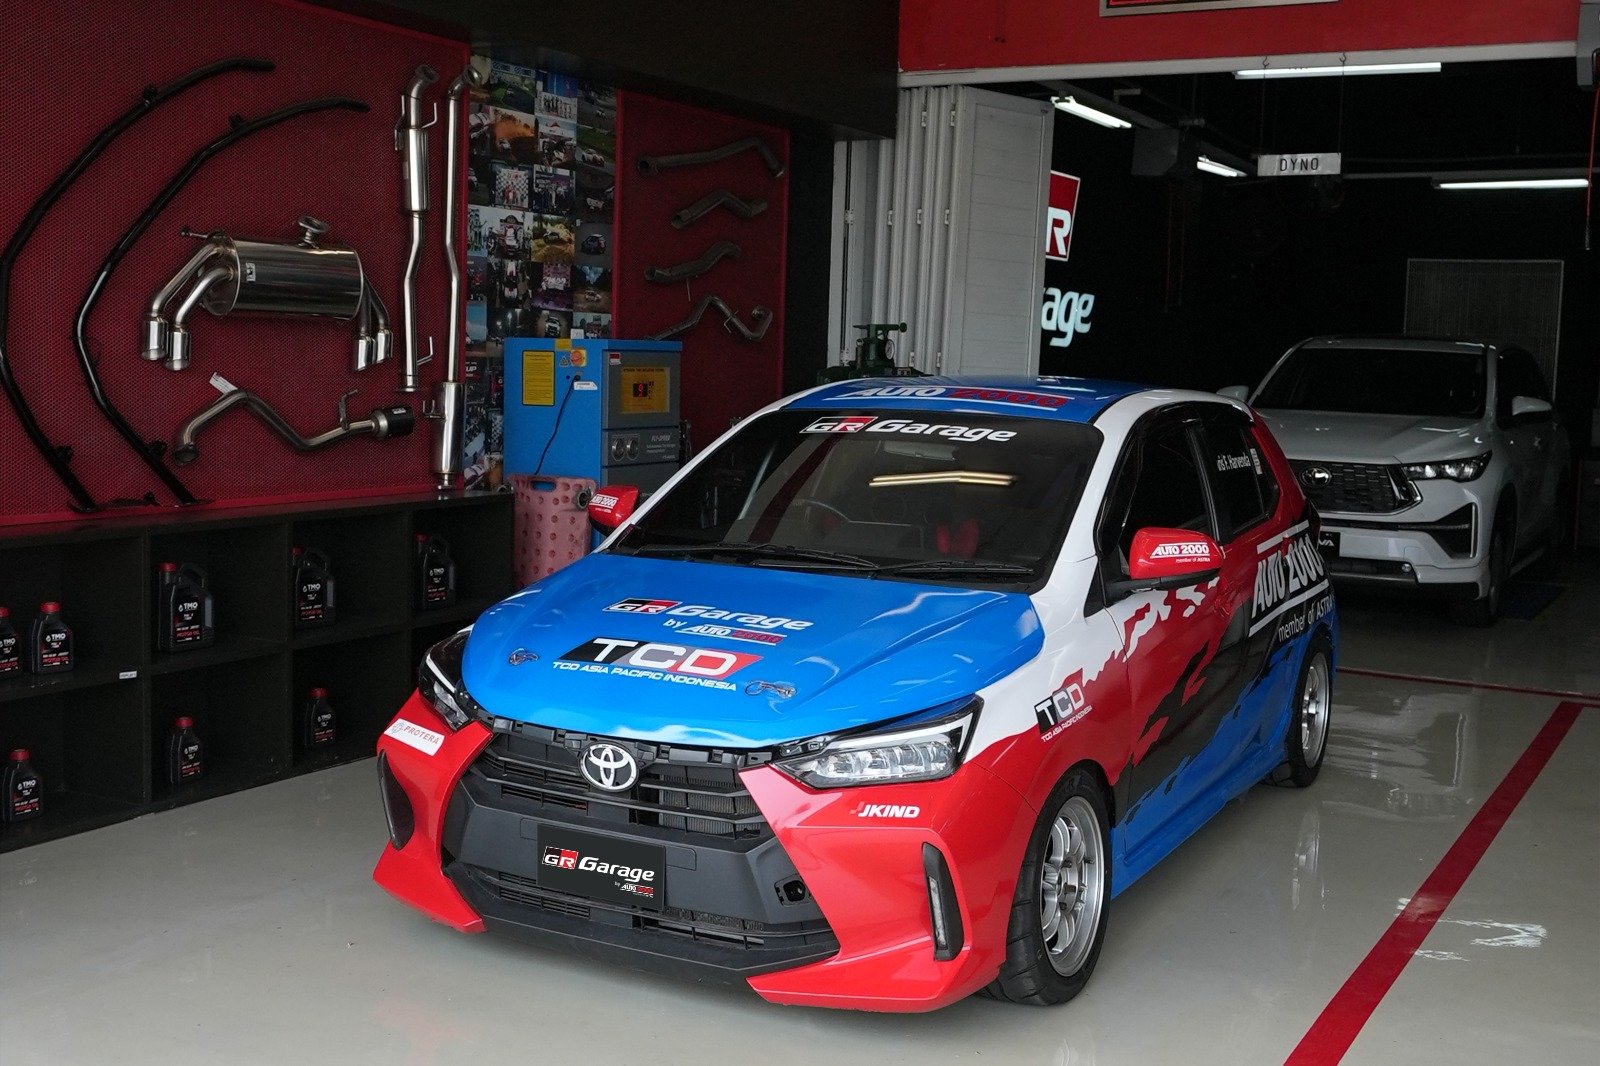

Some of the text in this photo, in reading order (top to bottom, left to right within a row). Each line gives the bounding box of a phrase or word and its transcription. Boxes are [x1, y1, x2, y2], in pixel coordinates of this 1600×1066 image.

[1280, 157, 1319, 172] DYNO
[1045, 206, 1072, 256] R
[1041, 286, 1095, 348] age
[839, 386, 1070, 407] AUTO 2000
[804, 419, 1018, 442] GR Garage
[1151, 544, 1210, 557] AUTO 2000
[1251, 533, 1325, 619] AUTO 2000
[183, 601, 198, 610] TMO
[606, 601, 814, 631] GR Garage
[1278, 594, 1333, 643] member of ASTRA
[51, 633, 66, 641] TMO
[662, 618, 783, 644] by AUTO 2000
[592, 637, 738, 677] TCD
[552, 661, 737, 691] TCD ASIA PACIFIC INDONESIA
[1035, 683, 1085, 725] TCD
[403, 725, 440, 744] PROTERA
[857, 804, 921, 818] JKIND
[543, 851, 655, 883] GR Garage
